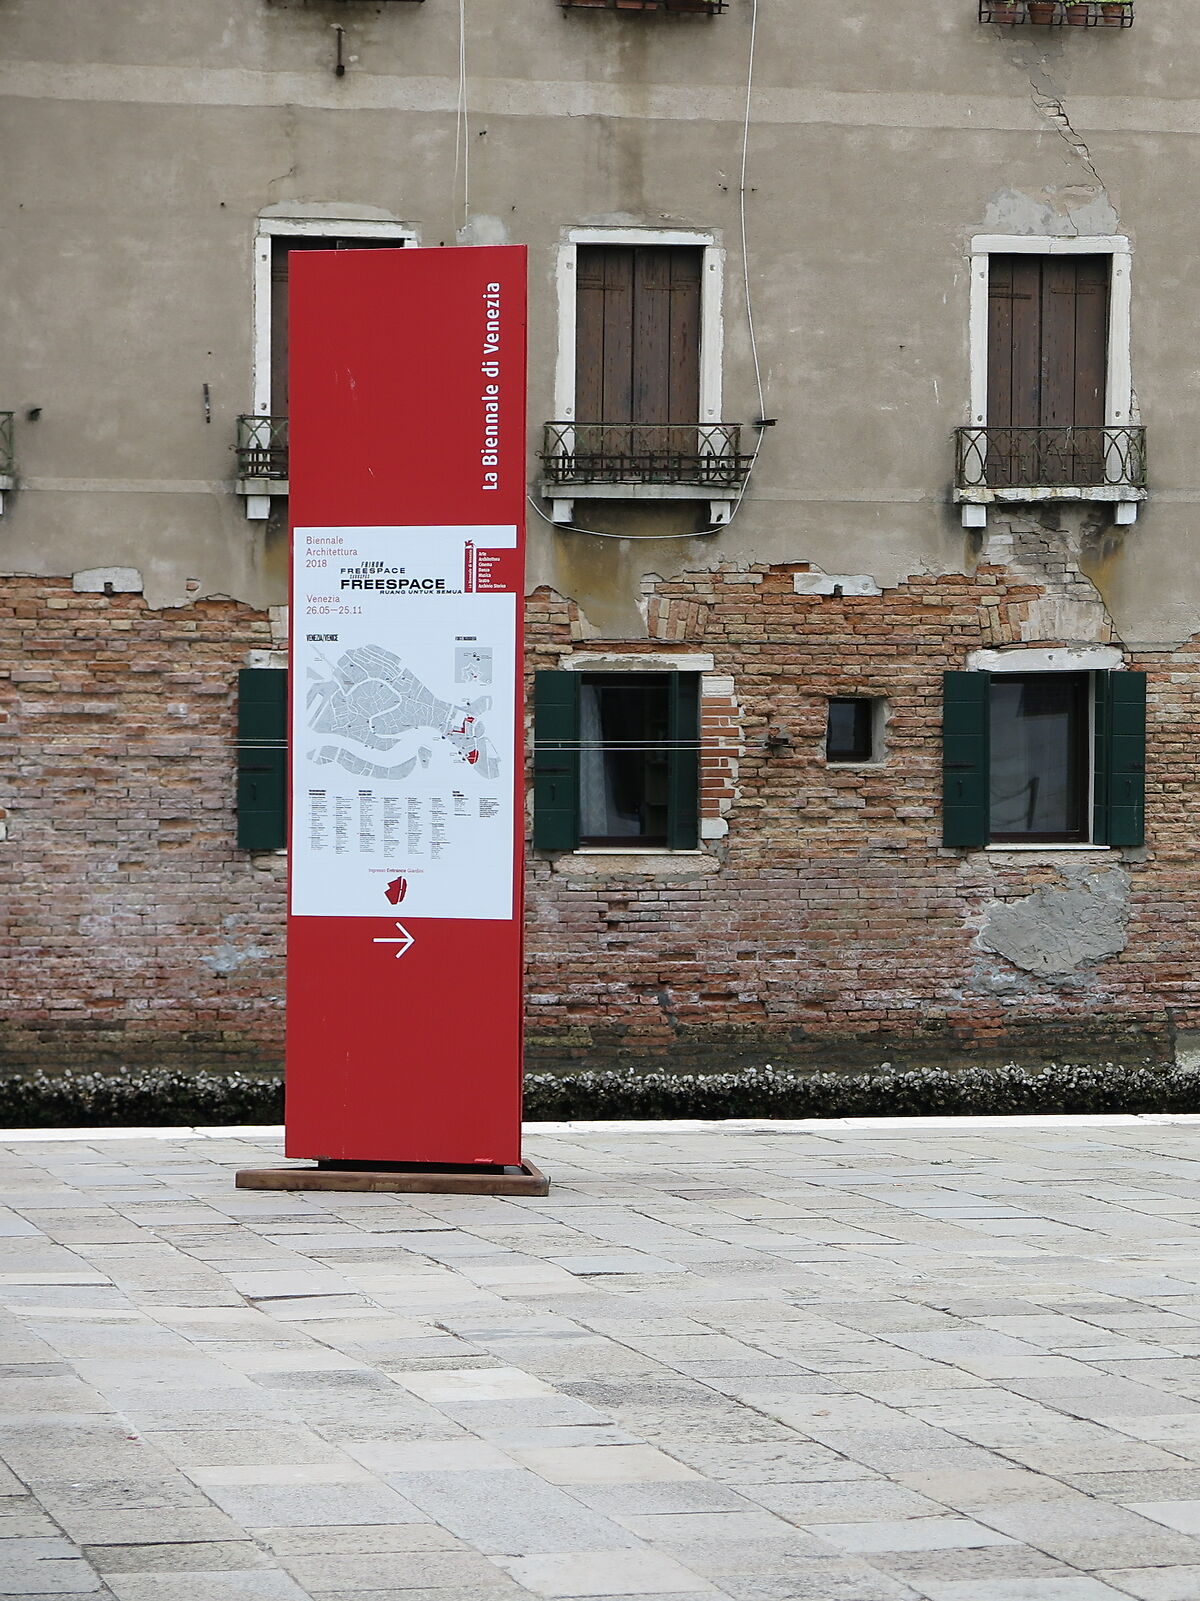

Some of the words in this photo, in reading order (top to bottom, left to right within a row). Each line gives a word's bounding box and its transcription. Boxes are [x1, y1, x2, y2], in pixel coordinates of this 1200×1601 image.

[482, 282, 500, 355] Venezia
[481, 361, 499, 378] di
[480, 384, 499, 466] Biennale
[482, 472, 498, 490] La
[306, 535, 344, 545] Biennale
[305, 547, 358, 556] Architettura
[305, 559, 328, 568] 2018
[340, 579, 446, 590] FREESPACE
[306, 594, 340, 603] Venezia
